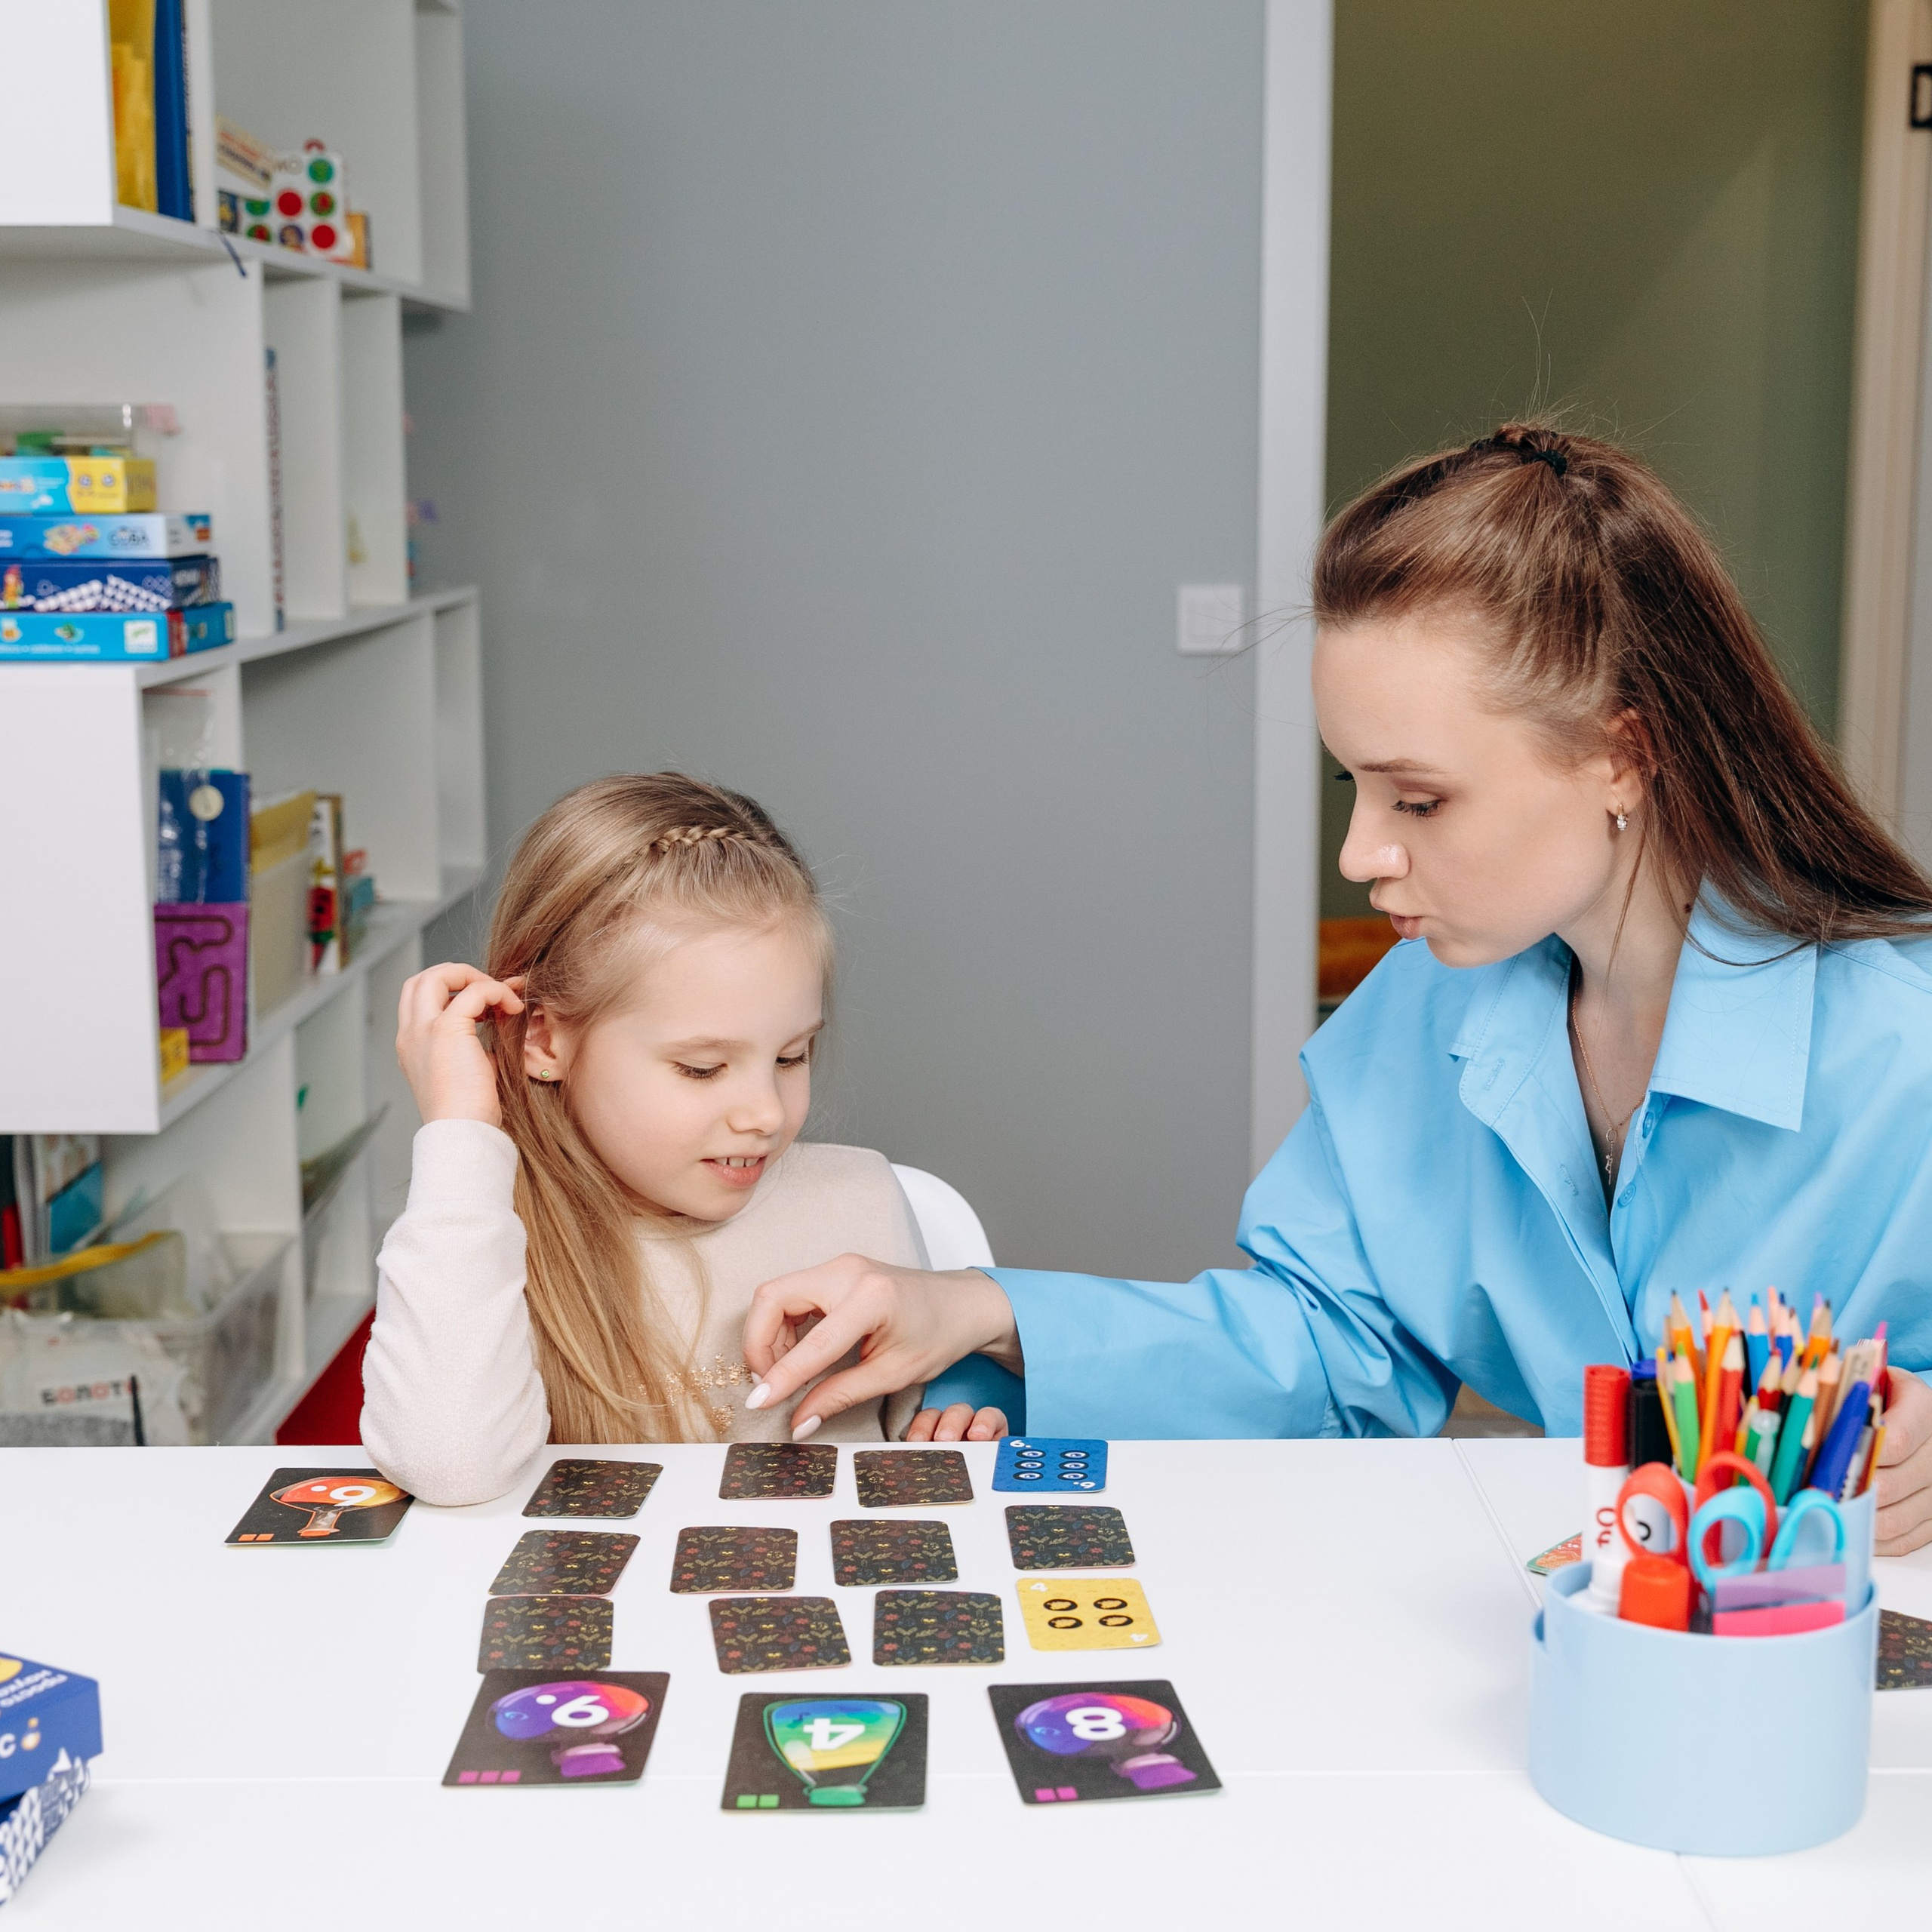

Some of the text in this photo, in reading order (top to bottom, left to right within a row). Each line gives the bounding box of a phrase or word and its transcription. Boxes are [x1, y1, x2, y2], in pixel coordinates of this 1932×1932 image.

[1030, 1582, 1049, 1593] 4
[1129, 1632, 1149, 1643] 4
[802, 1718, 866, 1750] 4
[1065, 1706, 1128, 1742] 8
